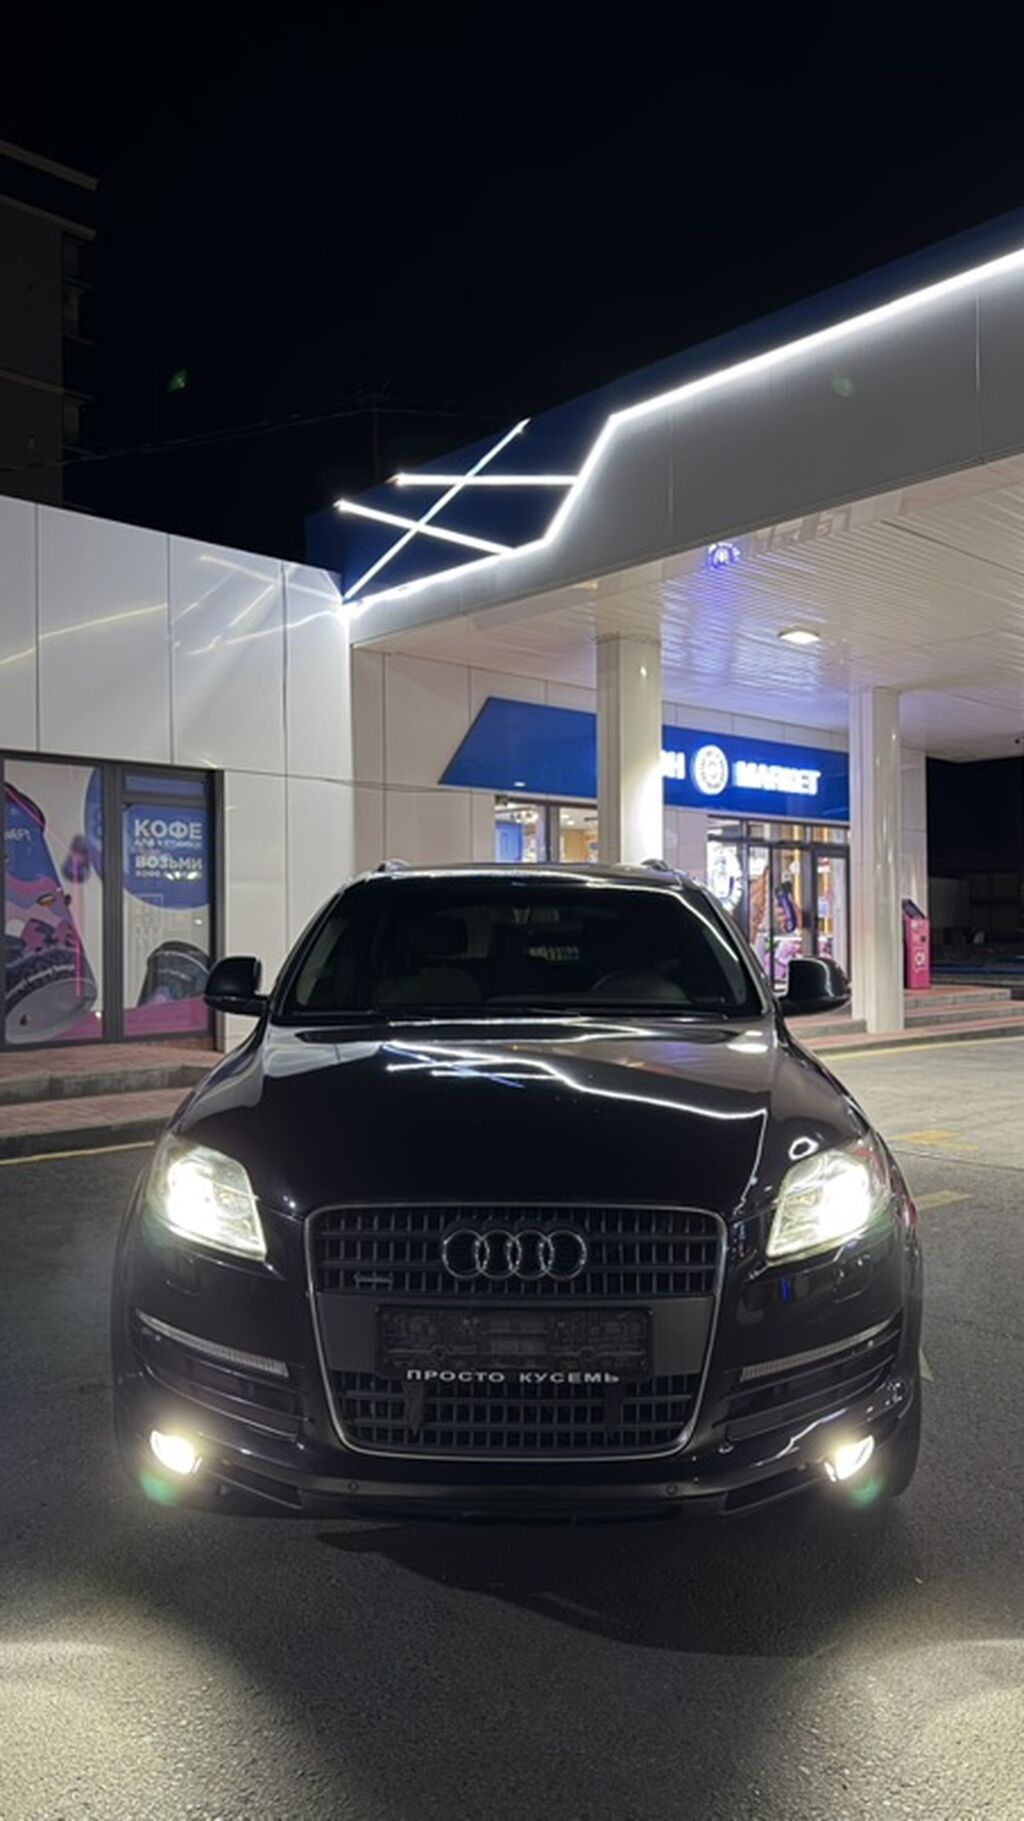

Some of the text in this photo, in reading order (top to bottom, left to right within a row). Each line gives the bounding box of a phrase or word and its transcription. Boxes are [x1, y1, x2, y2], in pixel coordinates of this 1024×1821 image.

[734, 761, 821, 795] MARKET
[134, 819, 203, 839] КОФЕ
[135, 855, 203, 870] ВОЗЬМИ
[406, 1368, 620, 1385] ПРОСТО КУСЕМЬ
